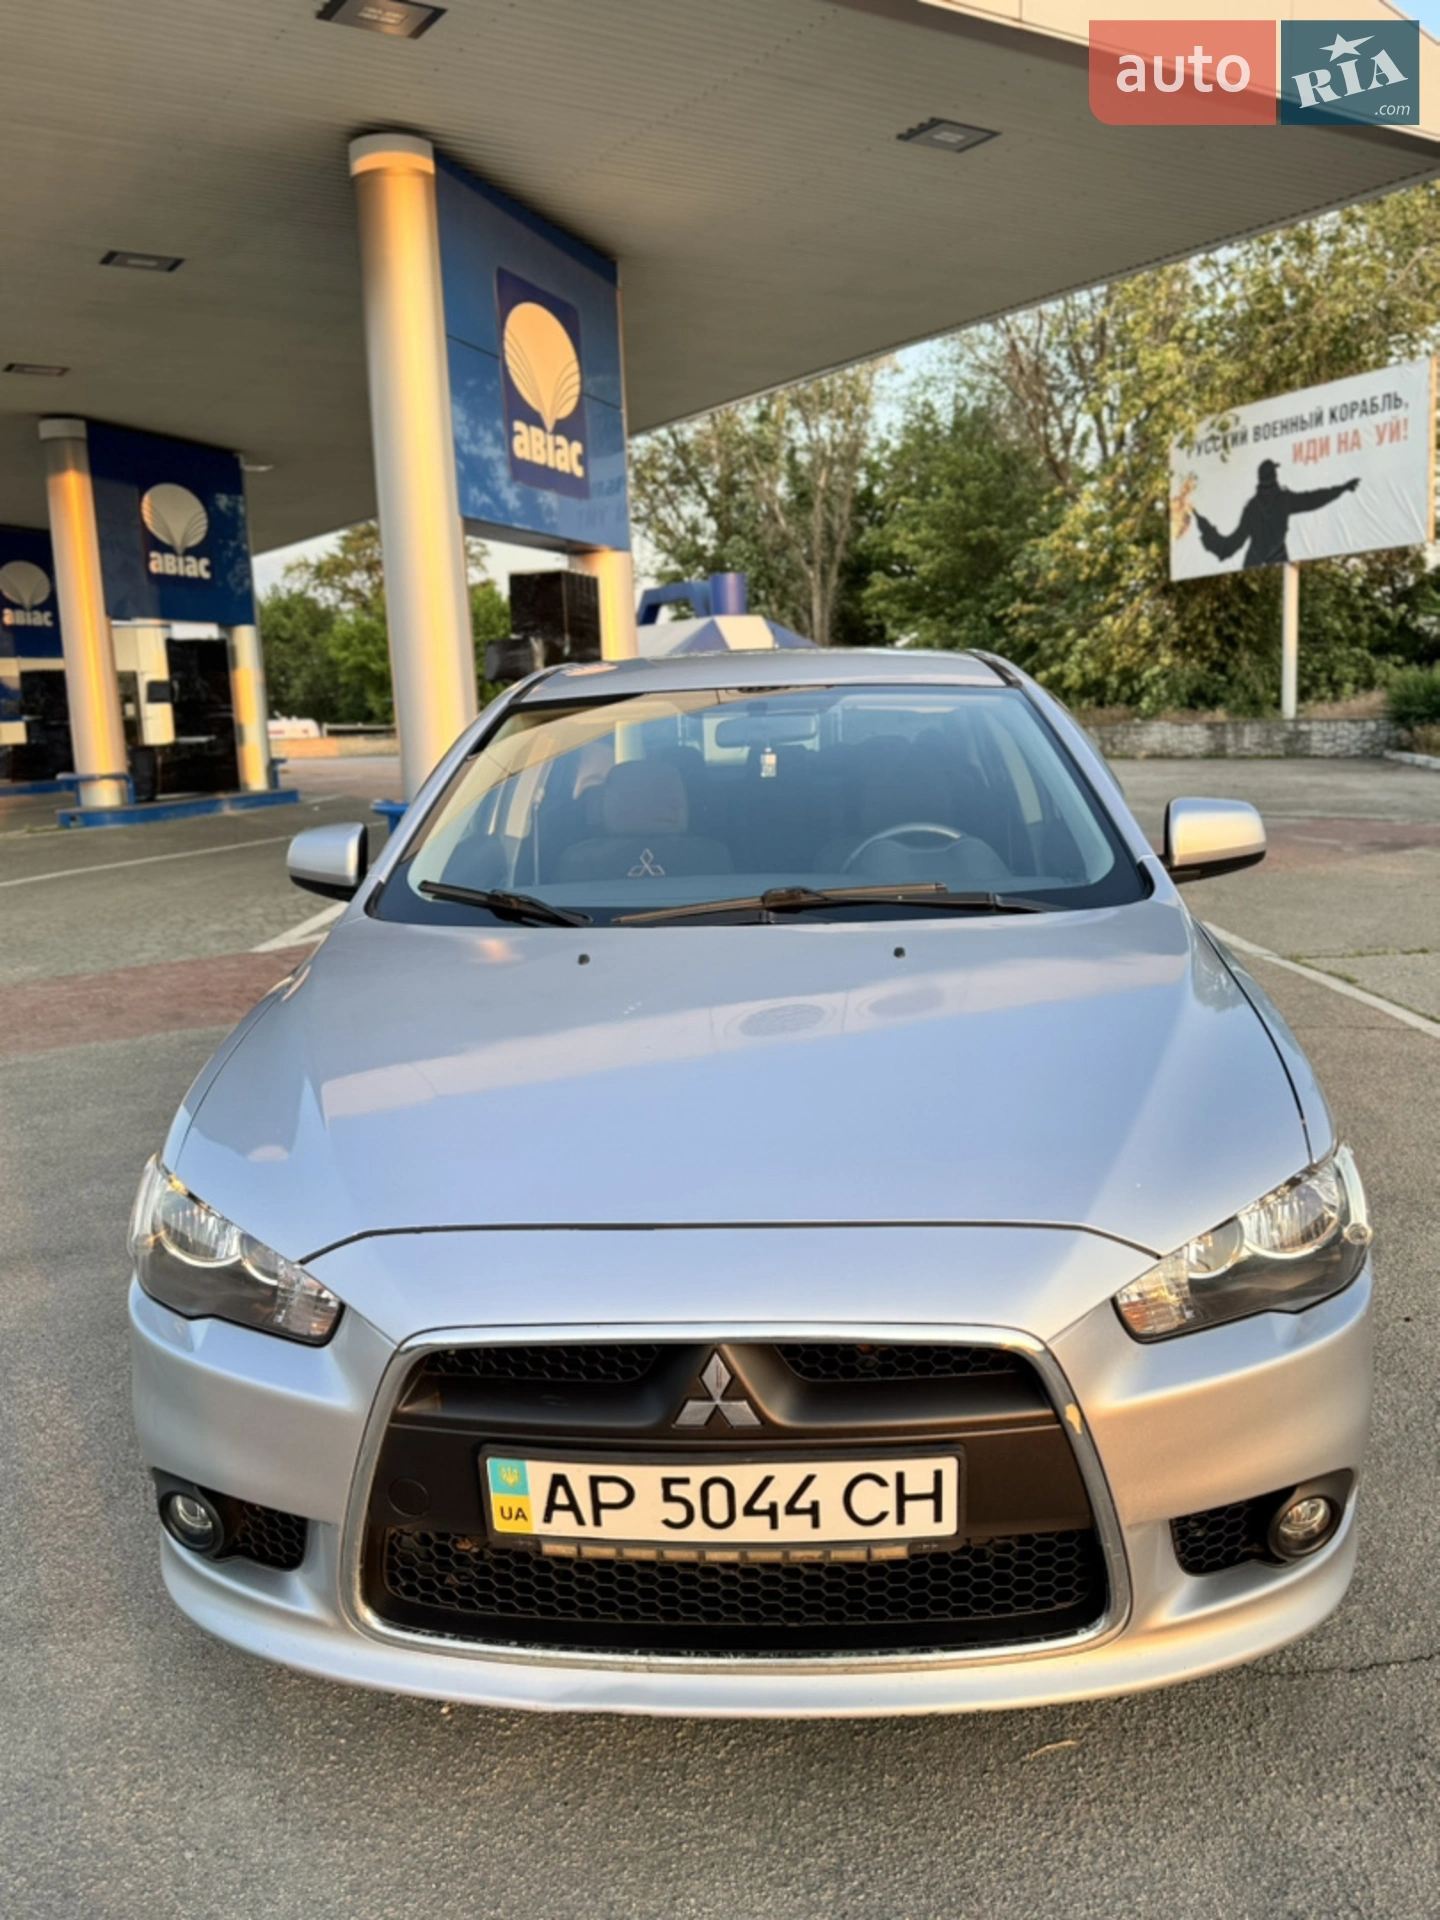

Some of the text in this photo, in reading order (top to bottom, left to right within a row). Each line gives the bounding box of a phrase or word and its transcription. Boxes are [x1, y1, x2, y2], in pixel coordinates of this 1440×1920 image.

[1186, 391, 1409, 459] УССИЙ ВОЕННЫЙ КОРАБЛЬ,
[1292, 437, 1331, 466] ИДИ
[1337, 428, 1362, 453] НА
[500, 1506, 528, 1522] UA
[542, 1469, 943, 1530] AP 5044 CH
